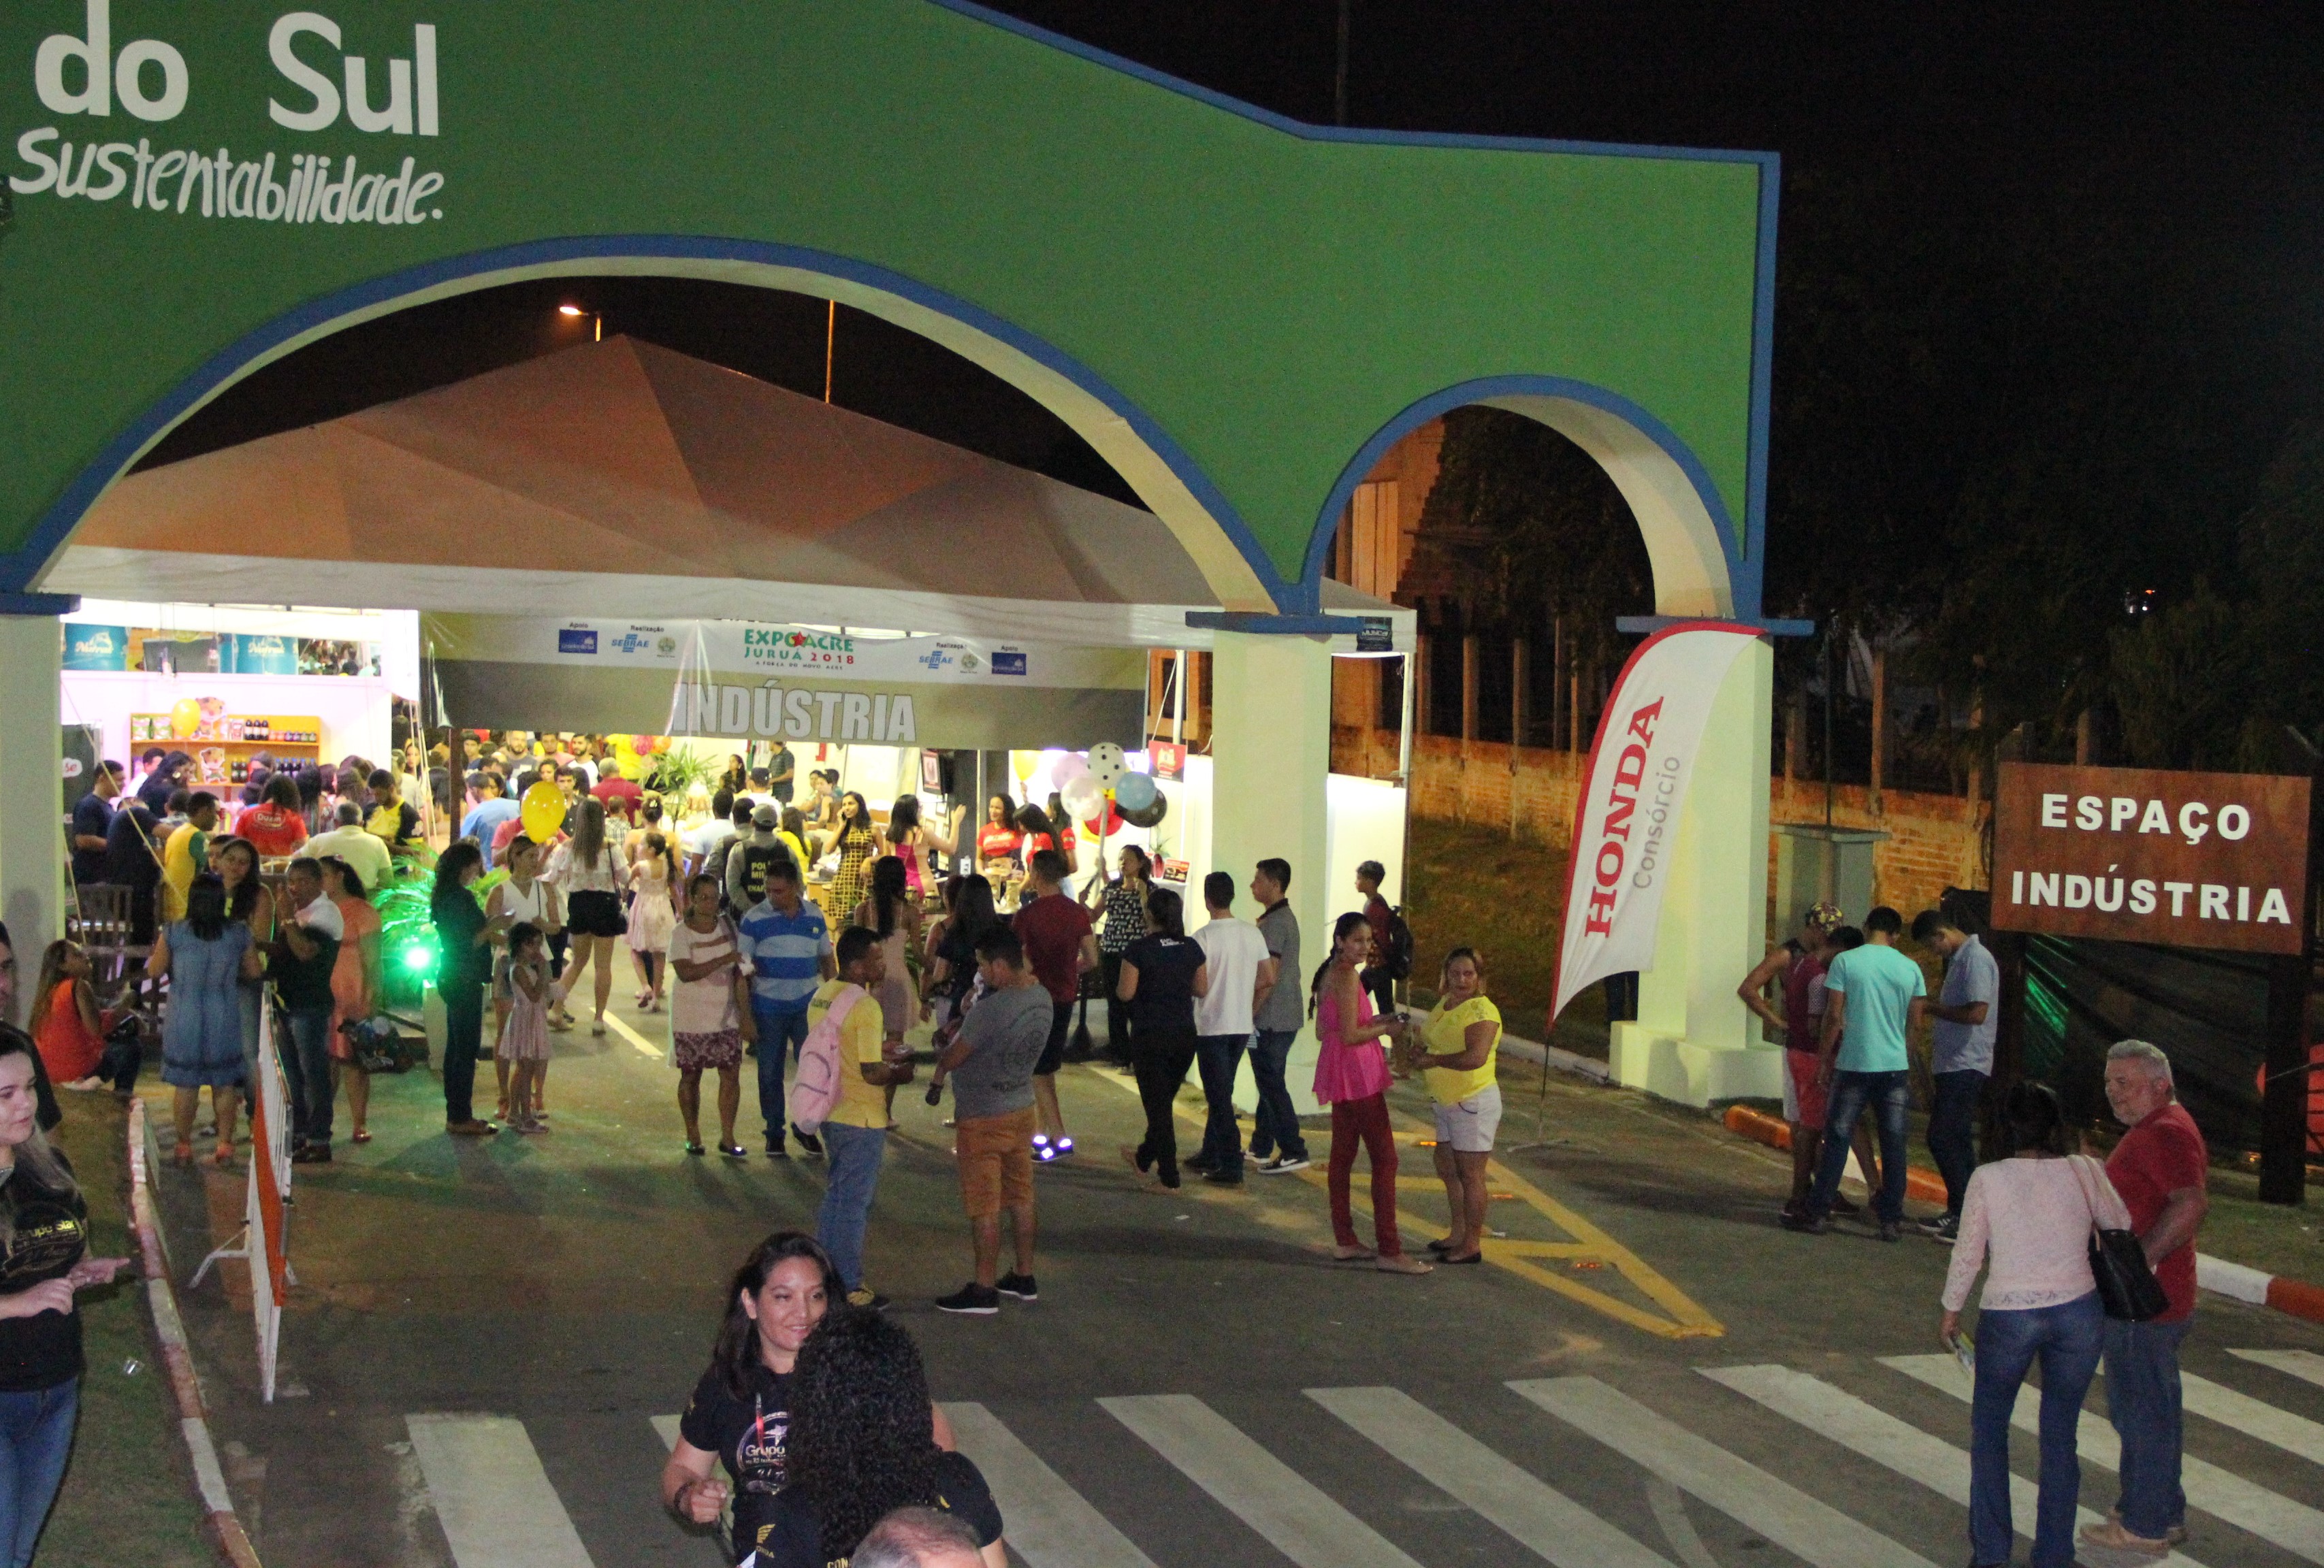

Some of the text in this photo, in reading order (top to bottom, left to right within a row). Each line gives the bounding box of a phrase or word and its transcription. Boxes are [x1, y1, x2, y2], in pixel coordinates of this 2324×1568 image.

[35, 0, 438, 135] do Sul
[10, 127, 445, 225] Sustentabilidade.
[611, 638, 649, 648] SEBRAE
[630, 625, 664, 633] Realização
[745, 629, 854, 652] EXPOACRE
[744, 647, 854, 664] JURUÁ 2018
[919, 655, 953, 664] SEBRAE
[671, 679, 917, 742] INDÚSTRIA
[1584, 696, 1664, 938] HONDA
[1633, 755, 1681, 890] Consórcio
[2041, 793, 2250, 845] ESPAÇO
[2011, 864, 2291, 924] INDÚSTRIA
[745, 1444, 786, 1456] Grupo
